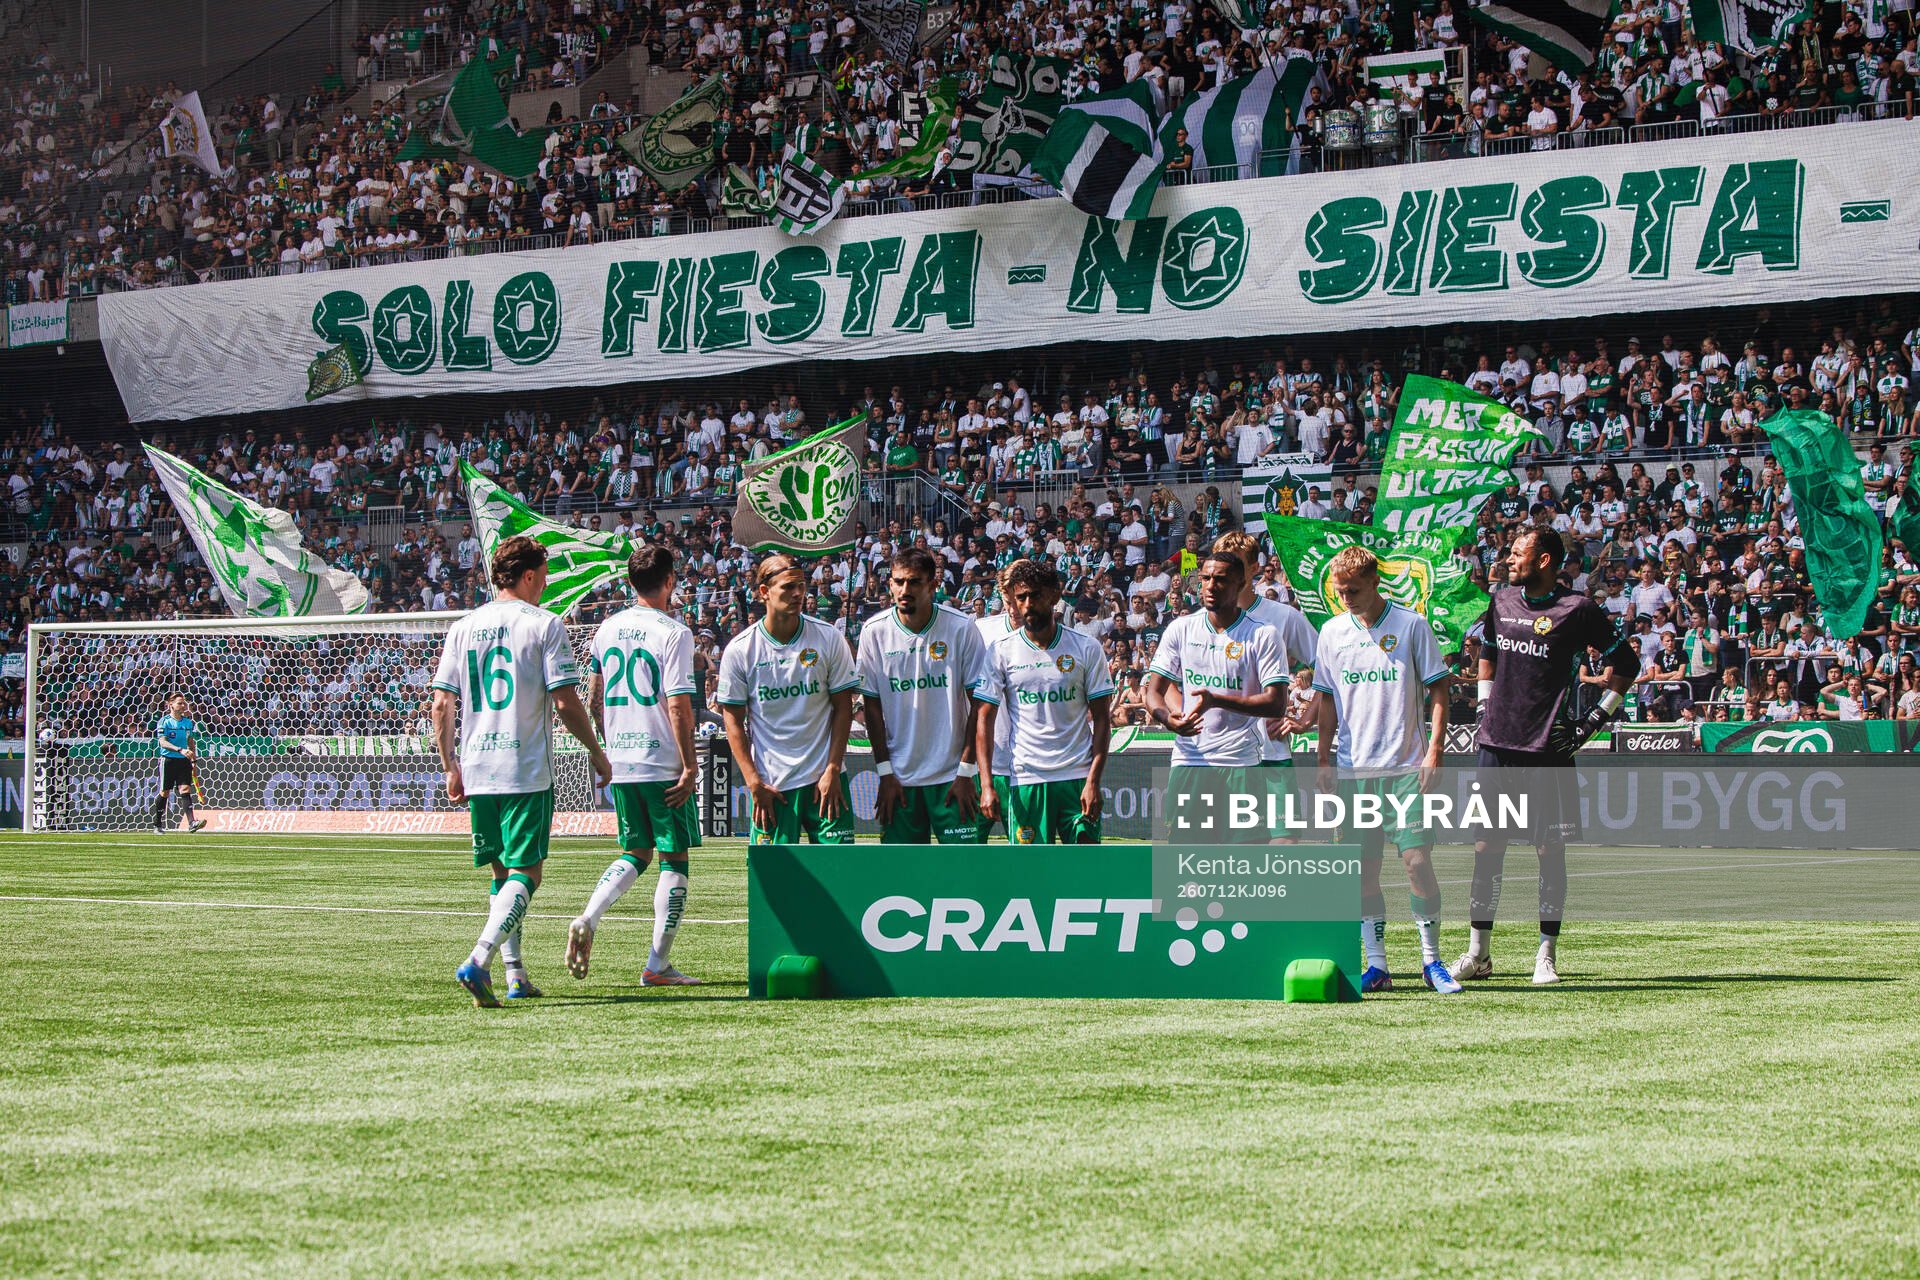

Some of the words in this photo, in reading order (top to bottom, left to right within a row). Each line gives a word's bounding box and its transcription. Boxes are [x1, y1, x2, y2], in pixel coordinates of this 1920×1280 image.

[313, 271, 562, 376] SOLO
[601, 229, 982, 358] FIESTA
[1008, 264, 1046, 286] -
[1067, 207, 1250, 314] NO
[1299, 158, 1805, 304] SIESTA
[1839, 199, 1891, 223] -
[1405, 398, 1488, 431] MER
[472, 626, 511, 642] PERSSON
[1496, 634, 1549, 659] Revolut
[467, 646, 514, 712] 16
[602, 646, 661, 707] 20
[889, 673, 948, 693] Revolut
[1185, 669, 1243, 690] Revolut
[1342, 666, 1398, 685] Revolut
[758, 680, 820, 701] Revolut
[1018, 686, 1076, 705] Revolut
[610, 739, 661, 749] WELLNESS
[1627, 733, 1681, 751] Söder
[711, 754, 729, 837] SELECT
[1662, 771, 1846, 831] BYGG
[217, 812, 296, 832] SYNSAM
[366, 812, 446, 832] SYNSAM
[663, 886, 687, 933] Clinton.
[861, 895, 1163, 953] CRAFT
